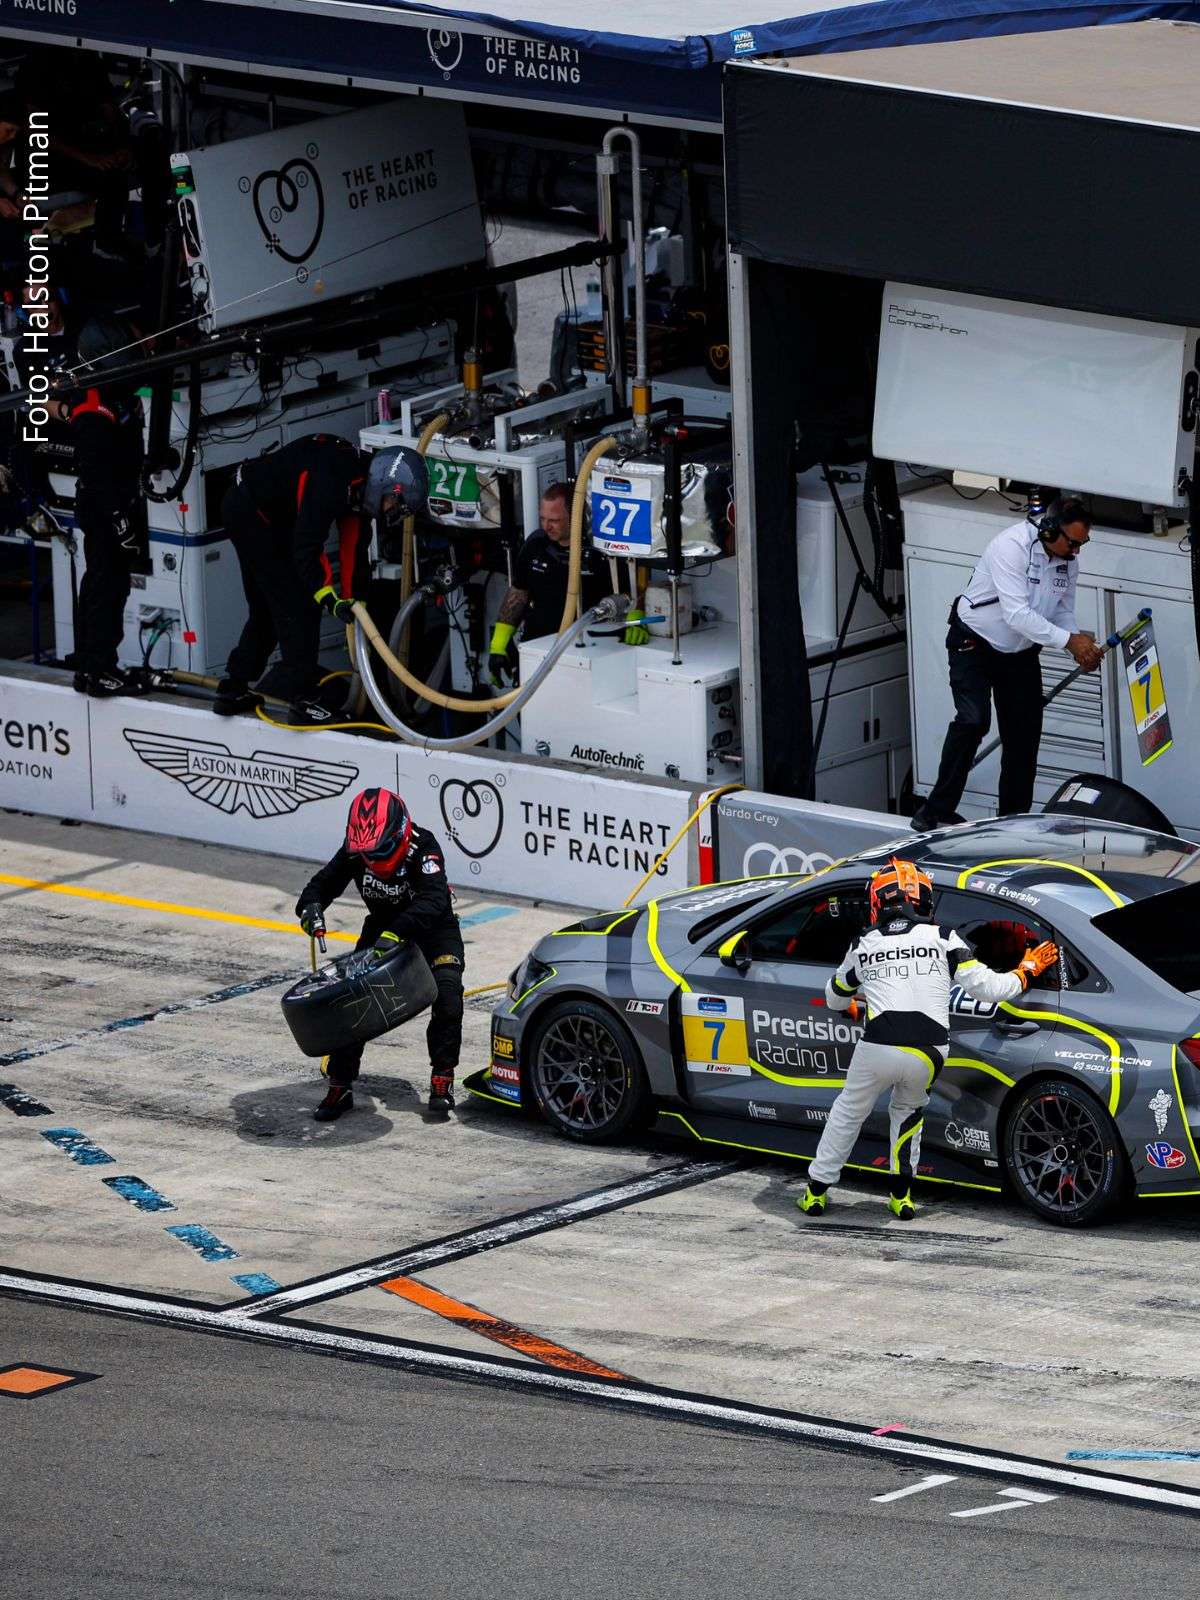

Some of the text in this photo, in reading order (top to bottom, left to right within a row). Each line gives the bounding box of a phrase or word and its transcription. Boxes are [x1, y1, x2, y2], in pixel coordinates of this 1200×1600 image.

[483, 36, 517, 56] THE
[485, 57, 581, 83] OF RACING
[343, 150, 435, 189] THE HEART
[349, 171, 437, 210] OF RACING
[434, 463, 467, 497] 27
[600, 499, 640, 536] 27
[1138, 671, 1150, 714] 7
[0, 719, 71, 756] en's
[192, 756, 291, 786] ASTON MARTIN
[570, 744, 645, 771] AutoTechnic
[520, 800, 671, 847] THE HEART
[717, 803, 779, 827] Nardo Grey
[524, 832, 668, 876] OF RACING
[986, 882, 1041, 907] R. Eversley
[859, 945, 940, 968] Precision
[861, 960, 942, 981] Racing LA
[641, 1003, 659, 1012] TCR
[752, 1009, 866, 1044] Precision
[494, 1040, 513, 1055] OMP
[703, 1021, 726, 1061] 7
[755, 1039, 829, 1074] Racing
[1054, 1050, 1109, 1062] VELOCITY
[492, 1064, 519, 1081] MOTUL
[963, 1127, 989, 1141] OESTE
[1145, 1142, 1172, 1168] VP
